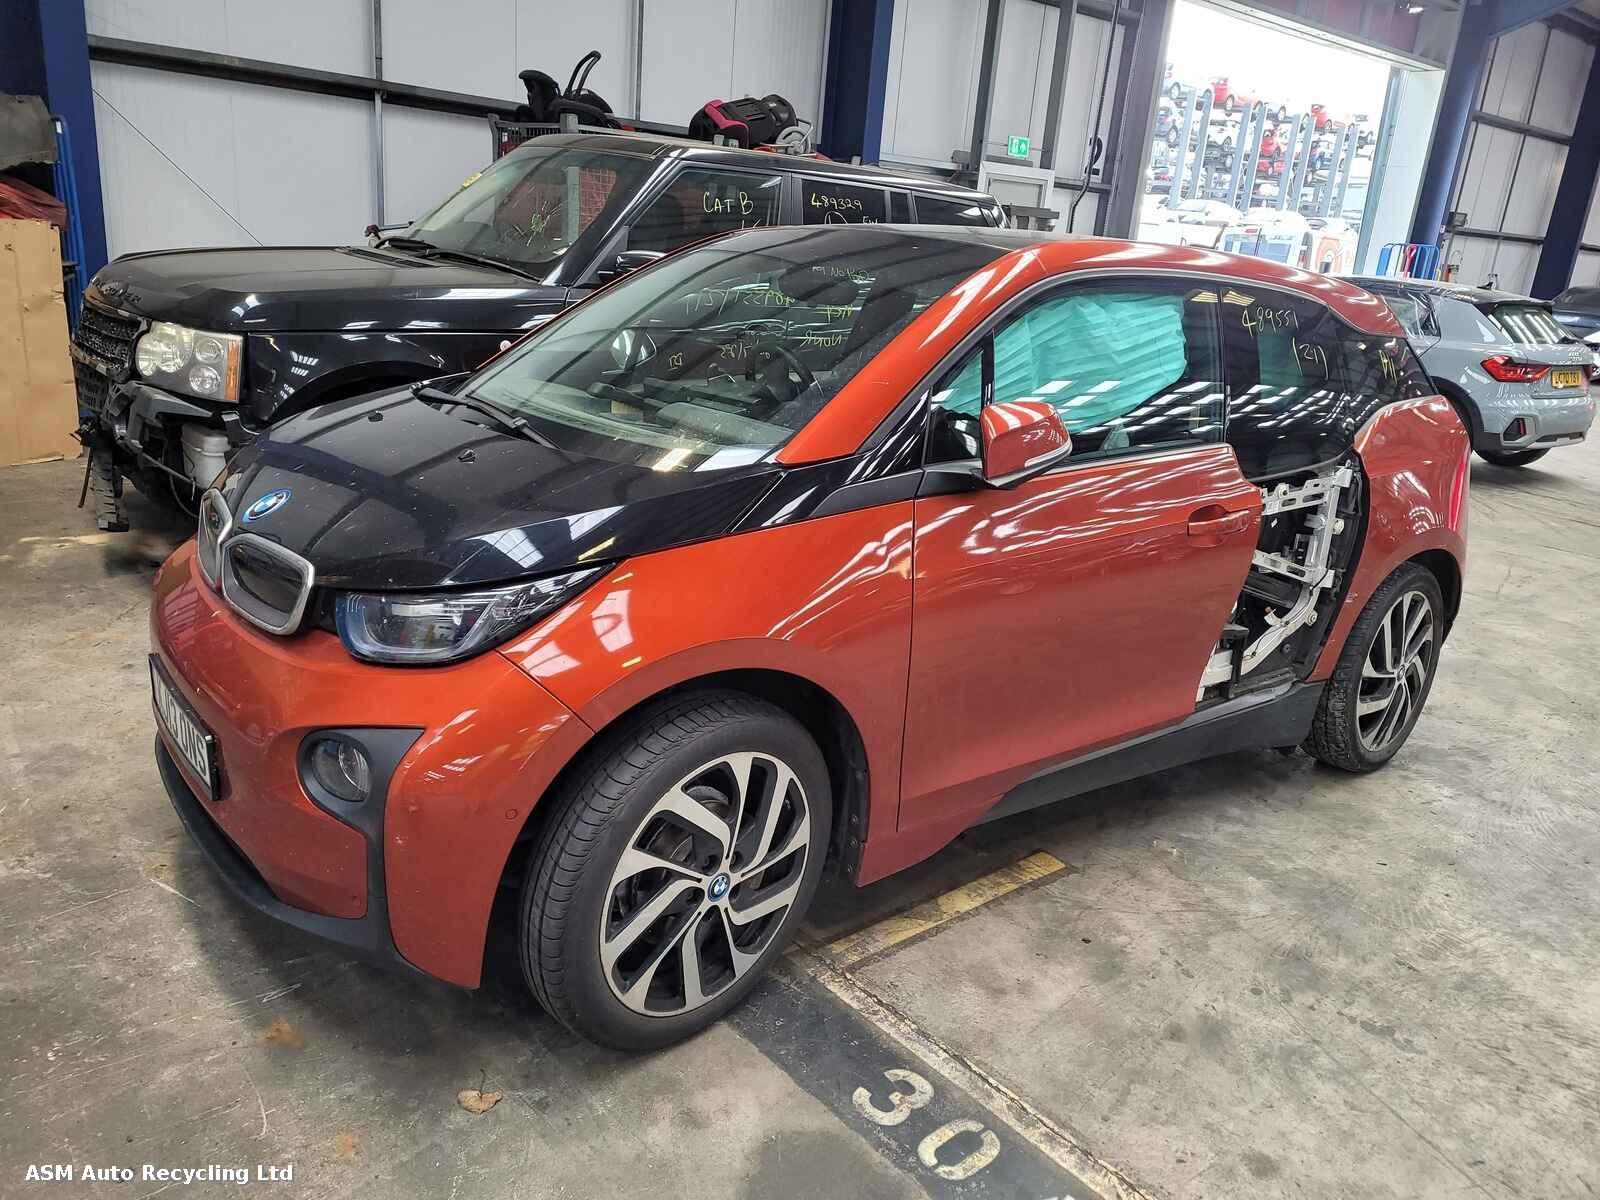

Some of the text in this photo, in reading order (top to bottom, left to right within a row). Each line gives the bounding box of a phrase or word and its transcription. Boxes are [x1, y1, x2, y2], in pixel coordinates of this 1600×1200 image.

[703, 191, 754, 215] CAT B
[811, 192, 863, 211] 489329
[1241, 306, 1299, 337] 489551
